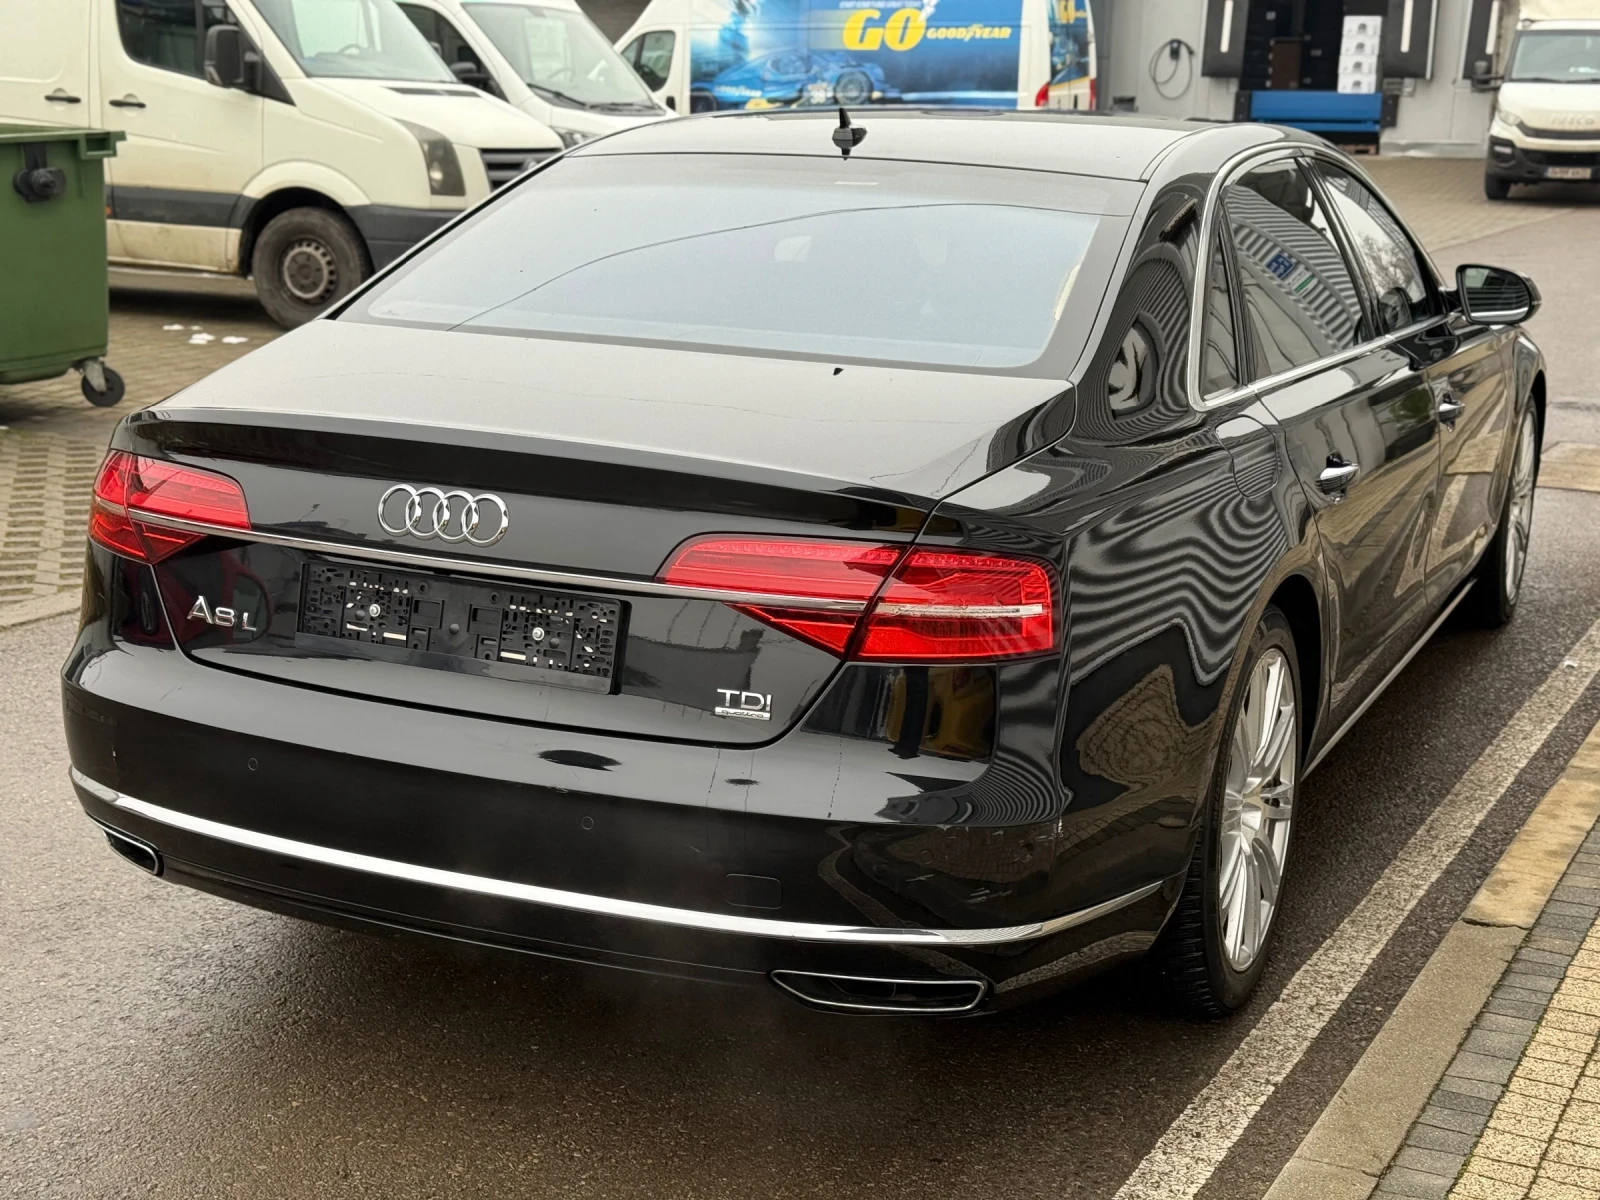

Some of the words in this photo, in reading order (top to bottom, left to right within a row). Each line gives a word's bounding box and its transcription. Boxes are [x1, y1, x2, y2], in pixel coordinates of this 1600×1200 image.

[842, 8, 927, 51] GO
[926, 23, 1012, 42] GOODYEAR
[187, 595, 235, 627] A8
[242, 612, 257, 631] L
[717, 688, 772, 711] TDI
[721, 709, 764, 719] quattro
